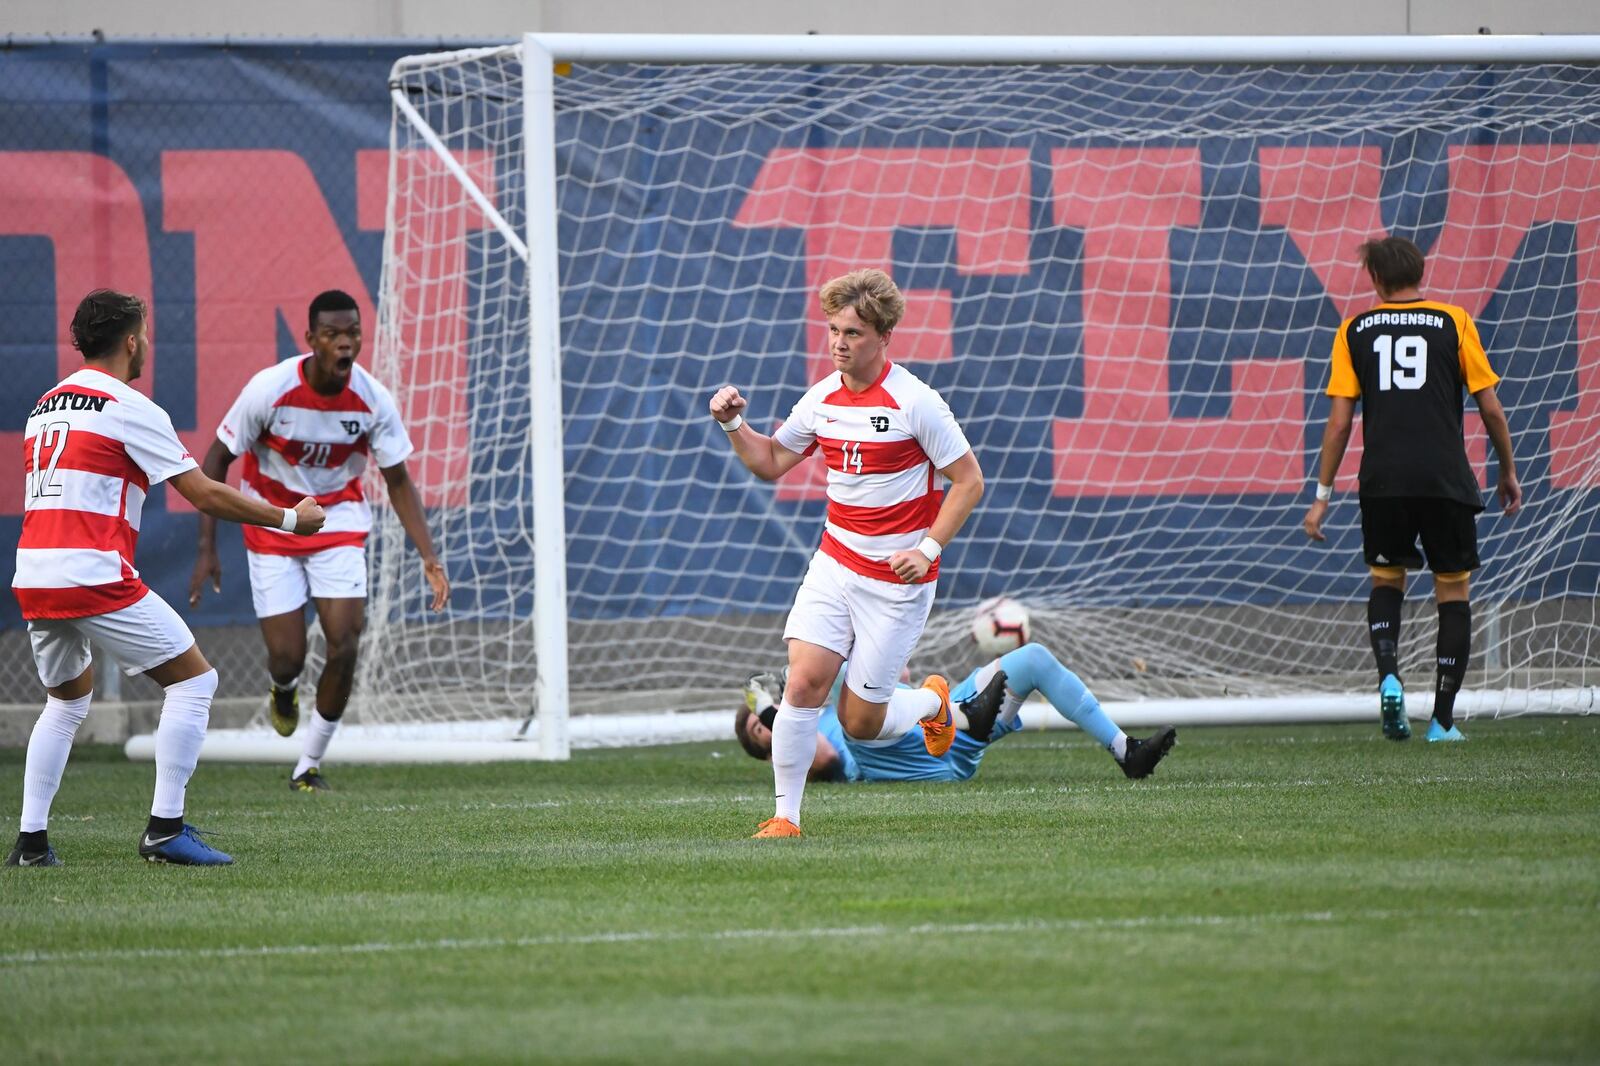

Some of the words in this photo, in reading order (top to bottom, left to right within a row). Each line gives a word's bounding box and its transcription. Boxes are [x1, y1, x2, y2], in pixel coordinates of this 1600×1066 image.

[732, 144, 1600, 502] FLY
[1356, 312, 1444, 333] JOERGENSEN
[1373, 334, 1428, 391] 19
[32, 421, 71, 498] 12
[297, 442, 332, 468] 20
[841, 440, 863, 475] 14
